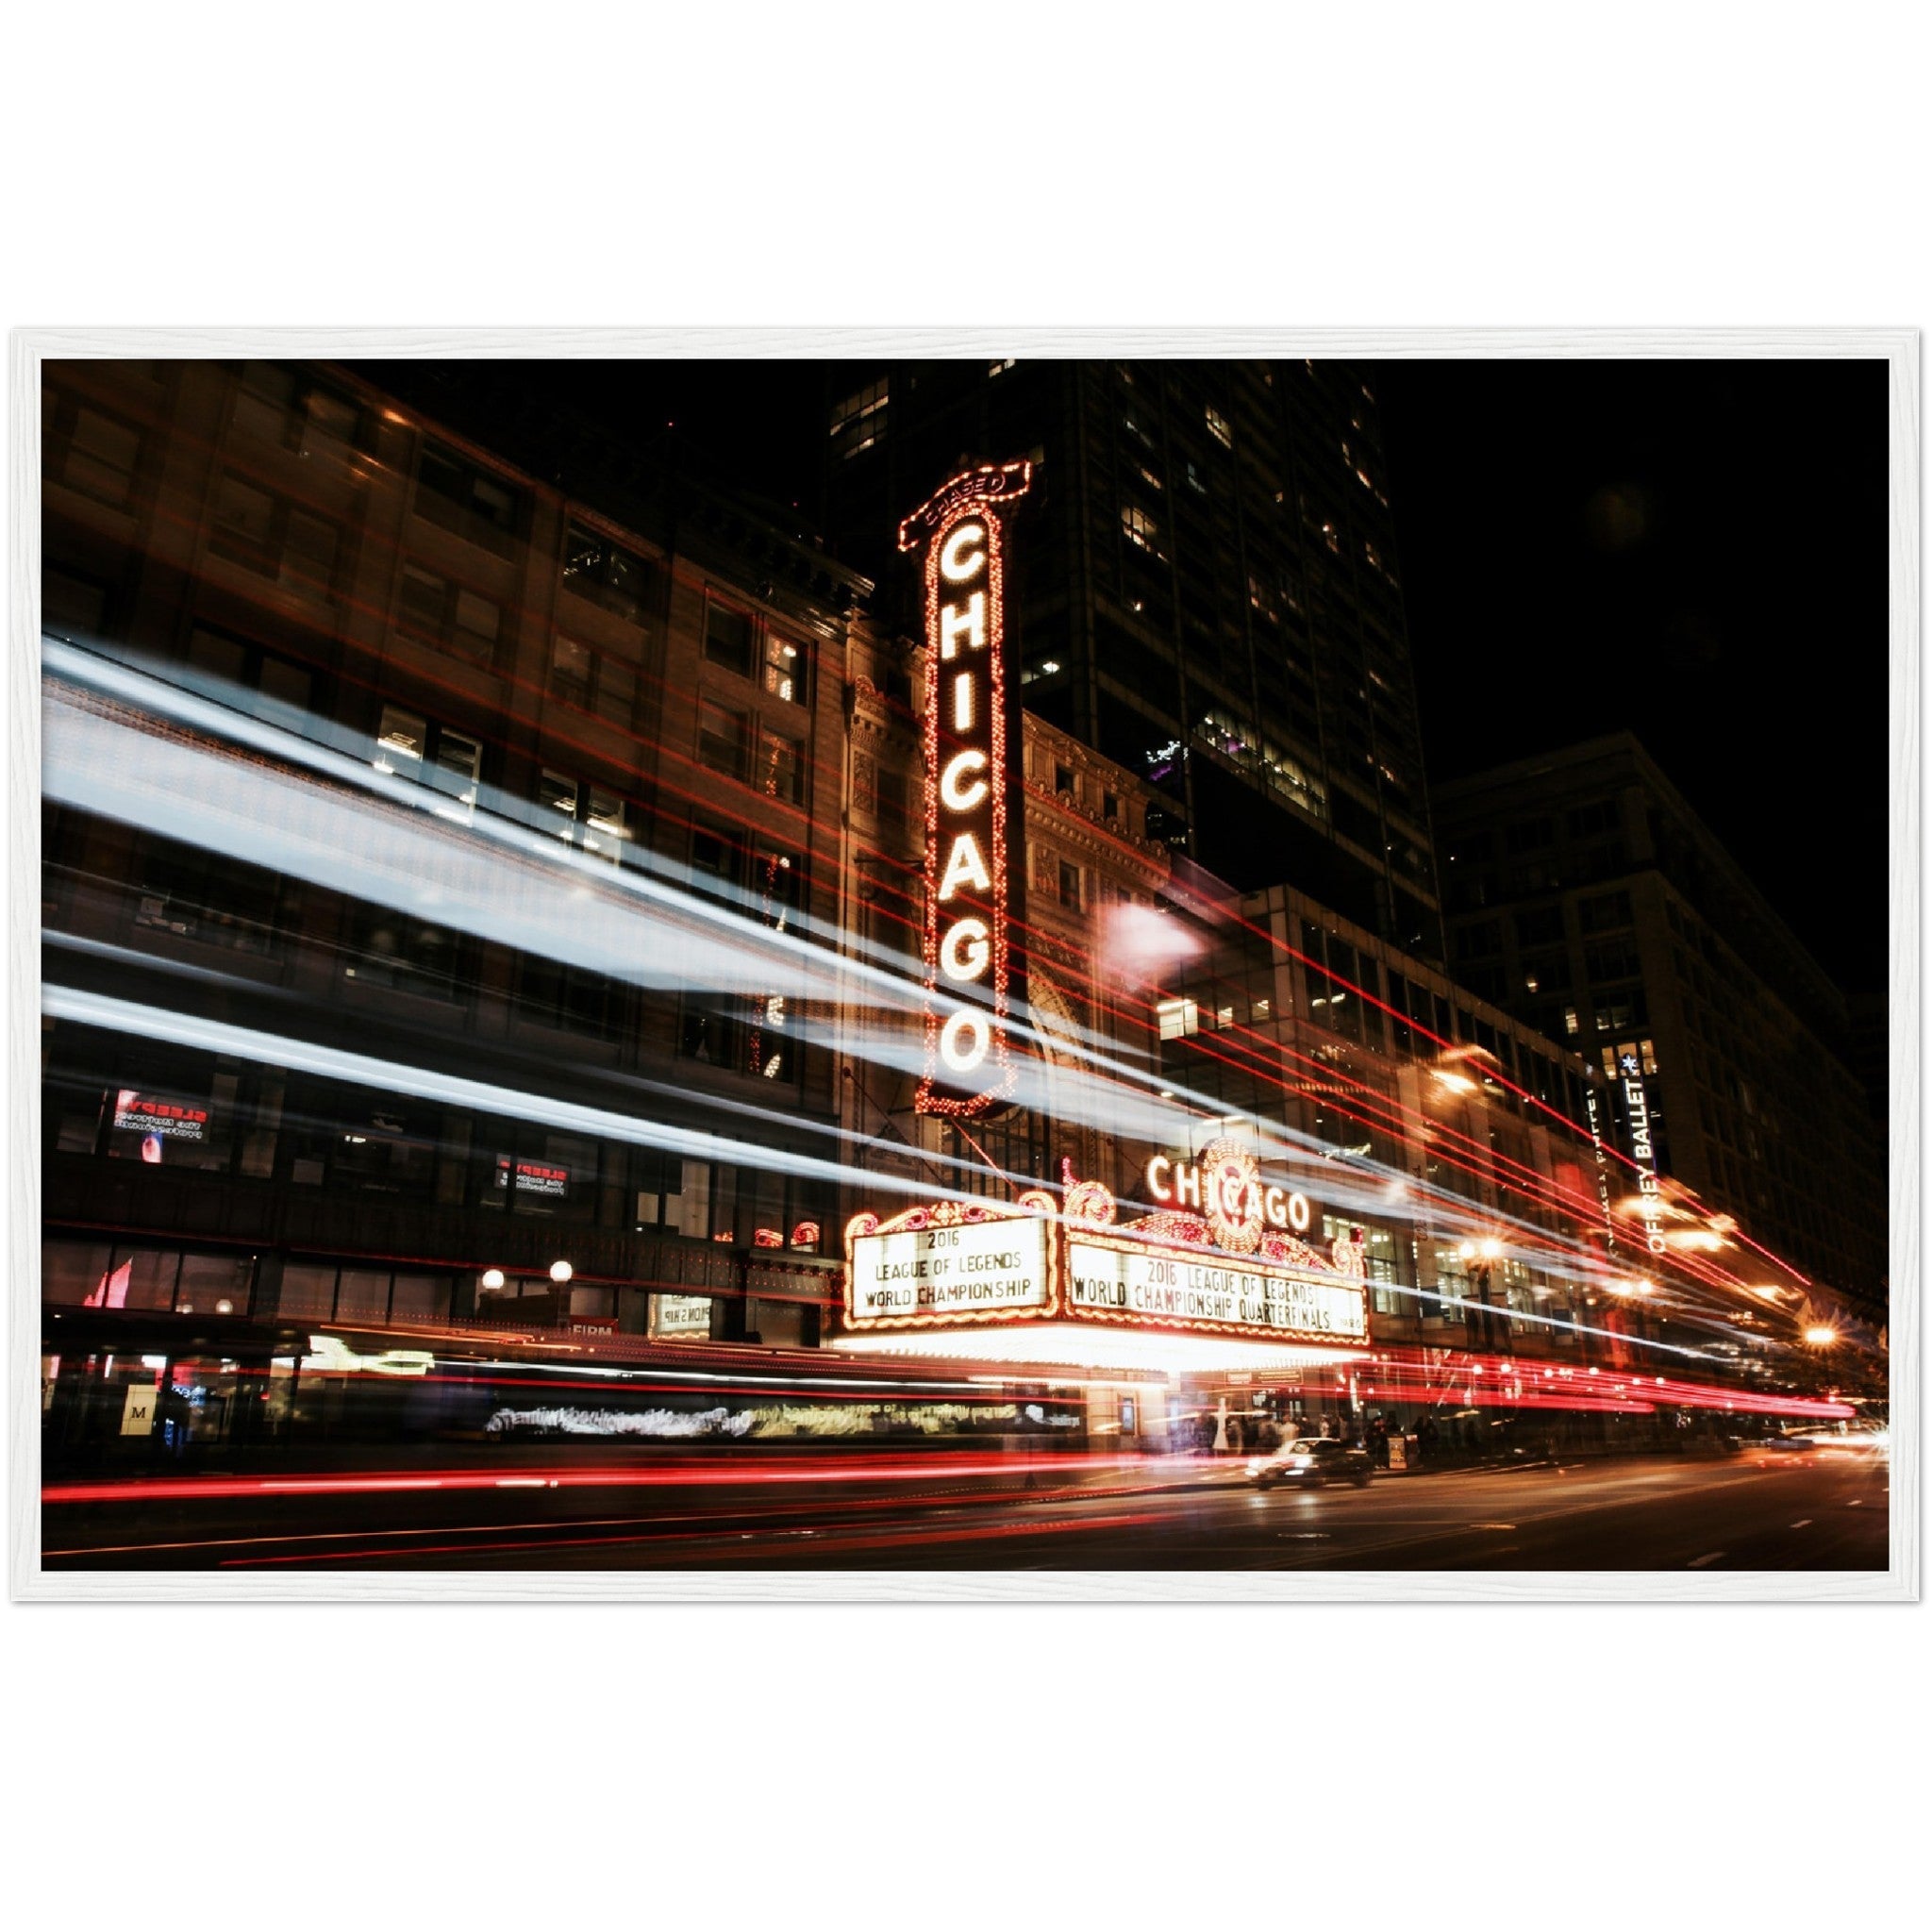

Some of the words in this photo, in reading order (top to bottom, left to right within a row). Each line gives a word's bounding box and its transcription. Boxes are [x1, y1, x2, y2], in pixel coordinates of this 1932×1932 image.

[939, 525, 991, 1071] CHICAGO
[1624, 1077, 1654, 1159] BALLET
[1147, 1155, 1310, 1230] CHICAGO
[927, 1230, 960, 1250] 2016
[875, 1260, 928, 1282] LEAGUE
[933, 1258, 952, 1275] OF
[958, 1251, 1022, 1274] LEGENDS
[1148, 1260, 1177, 1286] 2016
[1187, 1266, 1236, 1294] LEAGUE
[1241, 1275, 1256, 1296] OF
[1263, 1278, 1314, 1306] LEGENDS
[866, 1289, 912, 1307] WORLD
[917, 1278, 1031, 1305] CHAMPIONSHIP
[1074, 1276, 1126, 1307] WORLD
[1134, 1285, 1232, 1319] CHAMPIONSHIP
[1239, 1298, 1330, 1330] QUARTERFINALS
[130, 1407, 146, 1419] M
